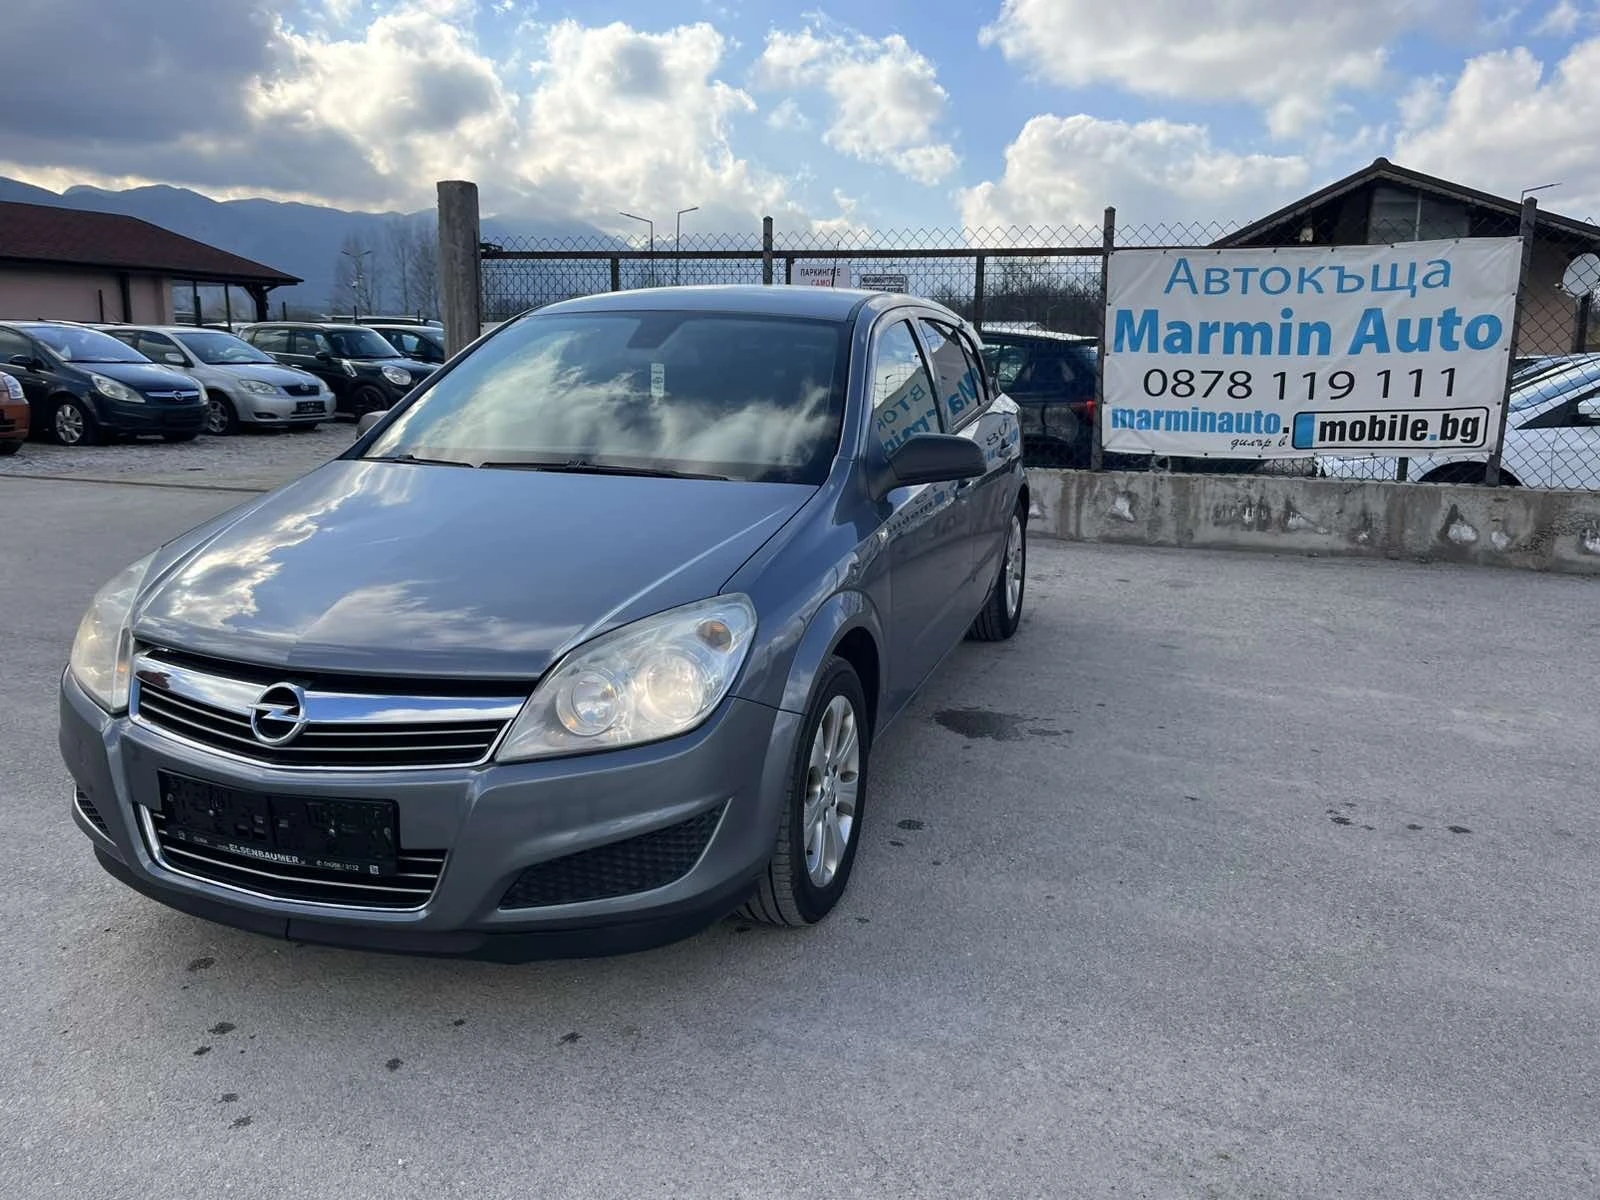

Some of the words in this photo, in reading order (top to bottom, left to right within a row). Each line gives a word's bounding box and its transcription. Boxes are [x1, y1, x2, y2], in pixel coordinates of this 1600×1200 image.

[1164, 256, 1452, 298] Автокъща
[1113, 307, 1332, 356] Marmin
[1348, 306, 1503, 355] Auto
[1143, 367, 1253, 400] 0878
[1272, 369, 1356, 400] 119
[1377, 367, 1457, 399] 111
[1318, 412, 1480, 444] mobile.bg
[229, 843, 299, 864] ELSENBAUMER
